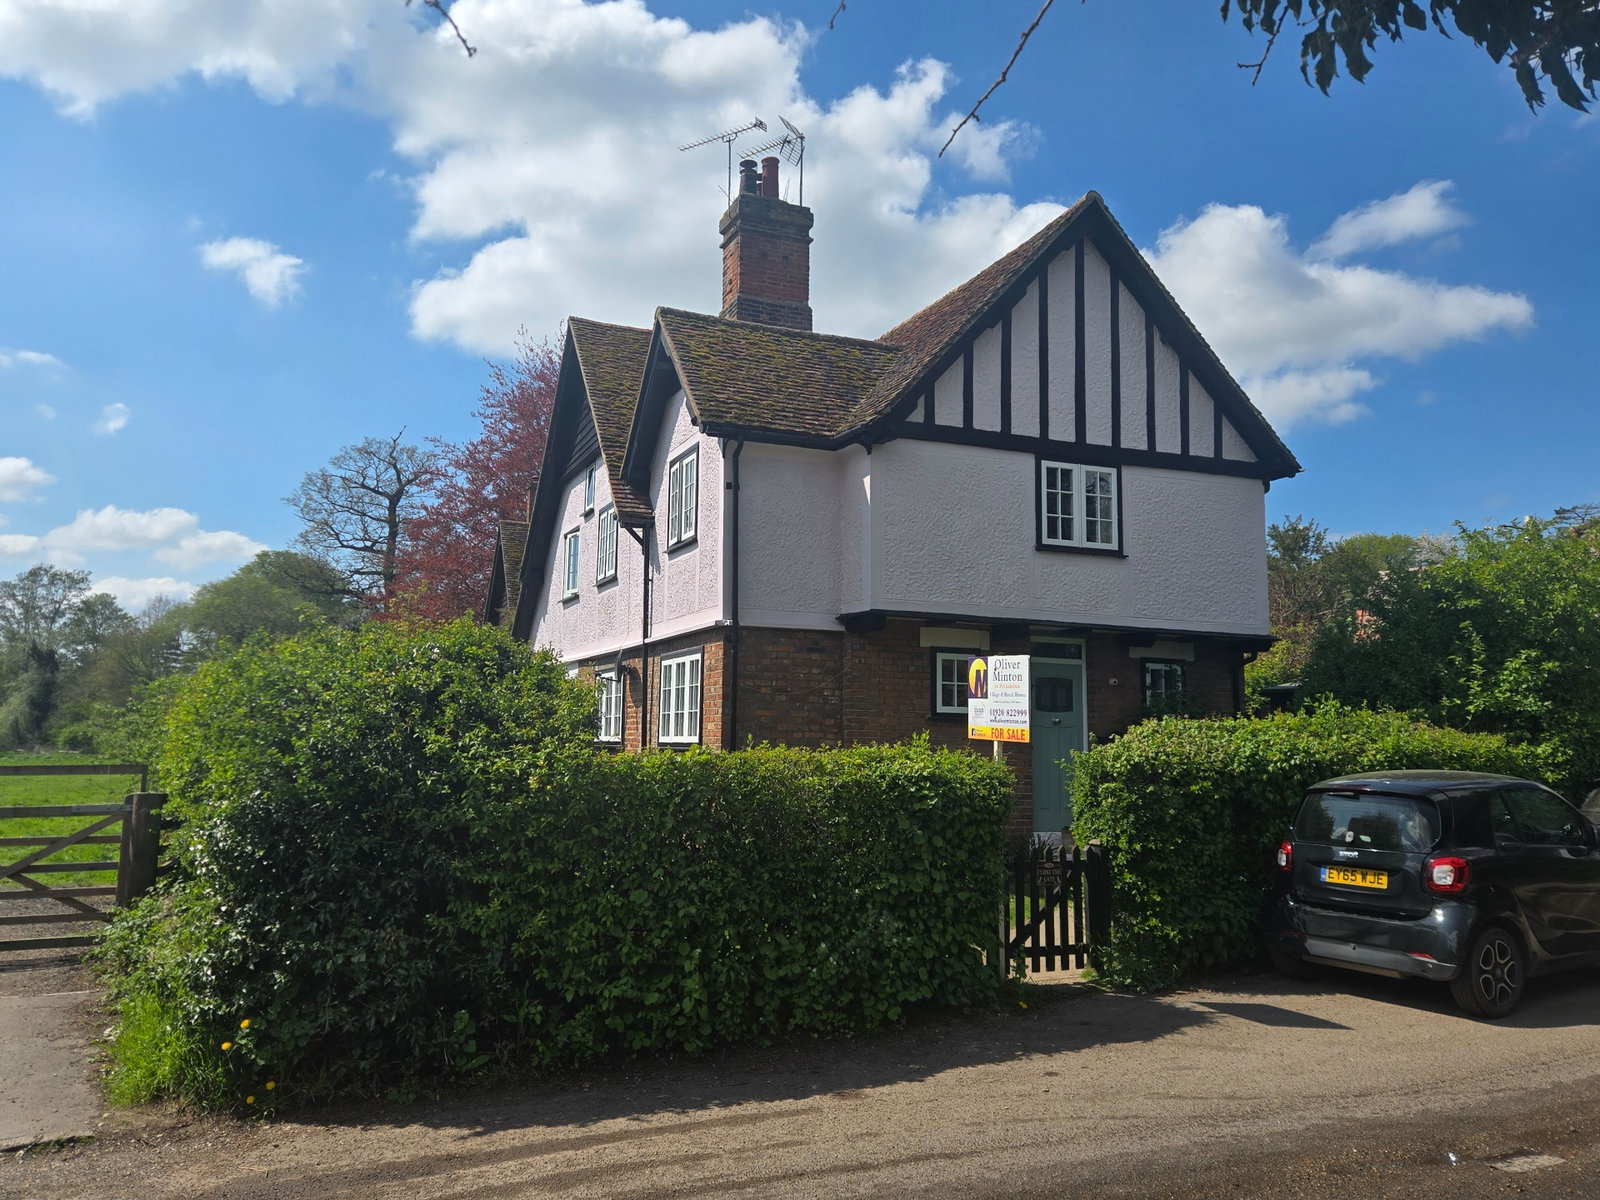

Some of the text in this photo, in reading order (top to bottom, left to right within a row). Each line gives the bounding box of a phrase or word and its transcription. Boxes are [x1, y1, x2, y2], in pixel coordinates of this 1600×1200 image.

[994, 658, 1021, 670] Oliver
[993, 671, 1022, 681] Minton
[1006, 709, 1027, 717] 822999
[991, 728, 1004, 739] FOR
[1007, 728, 1025, 740] SALE
[1328, 867, 1385, 885] EY65 WJE
